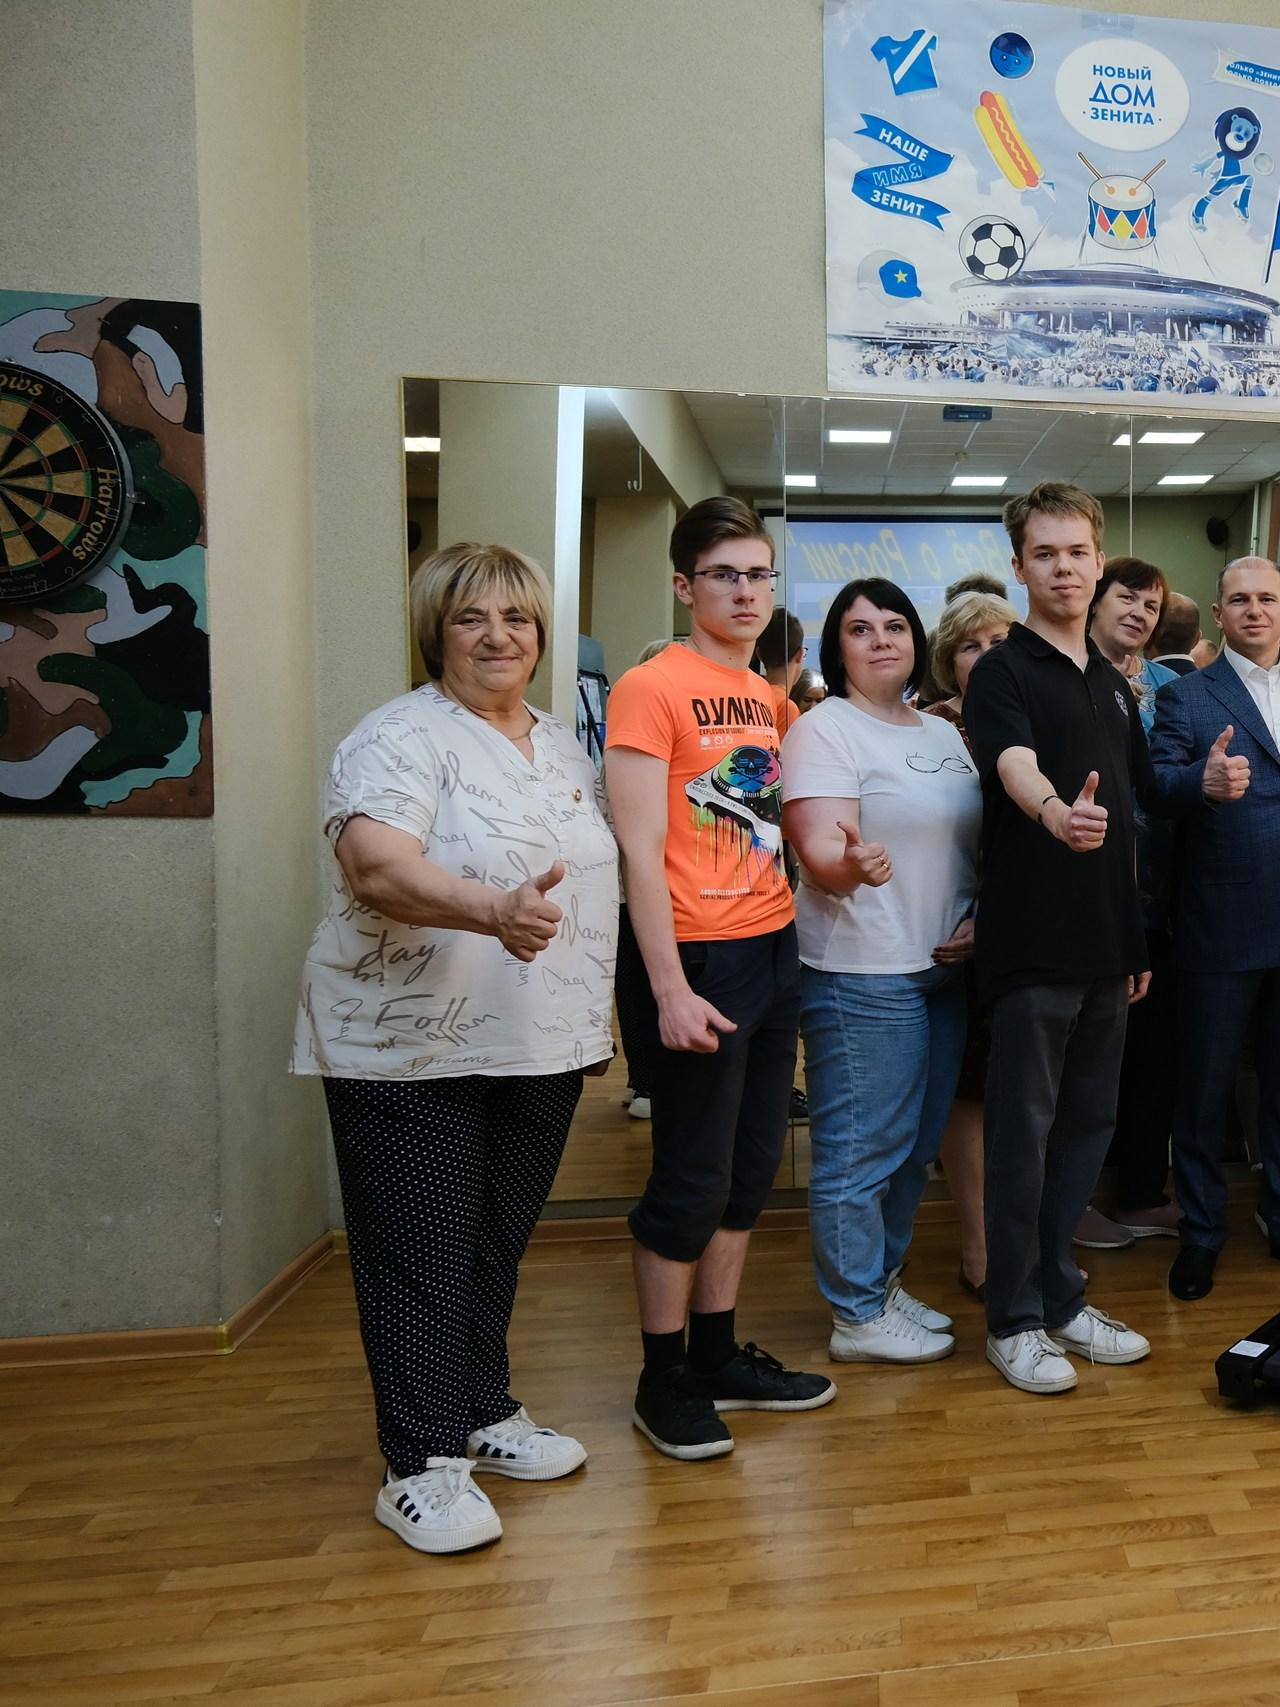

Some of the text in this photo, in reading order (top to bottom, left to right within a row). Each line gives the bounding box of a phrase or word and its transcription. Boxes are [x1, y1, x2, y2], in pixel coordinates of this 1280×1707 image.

[1093, 64, 1151, 80] НОВЫЙ
[1229, 62, 1255, 74] ОЛЬКО
[1089, 80, 1155, 108] ДОМ
[1090, 107, 1154, 125] ЗЕНИТА
[879, 128, 929, 161] НАШЕ
[873, 163, 923, 187] ИМЯ
[870, 190, 925, 216] ЗЕНИТ
[71, 466, 119, 561] Harrows
